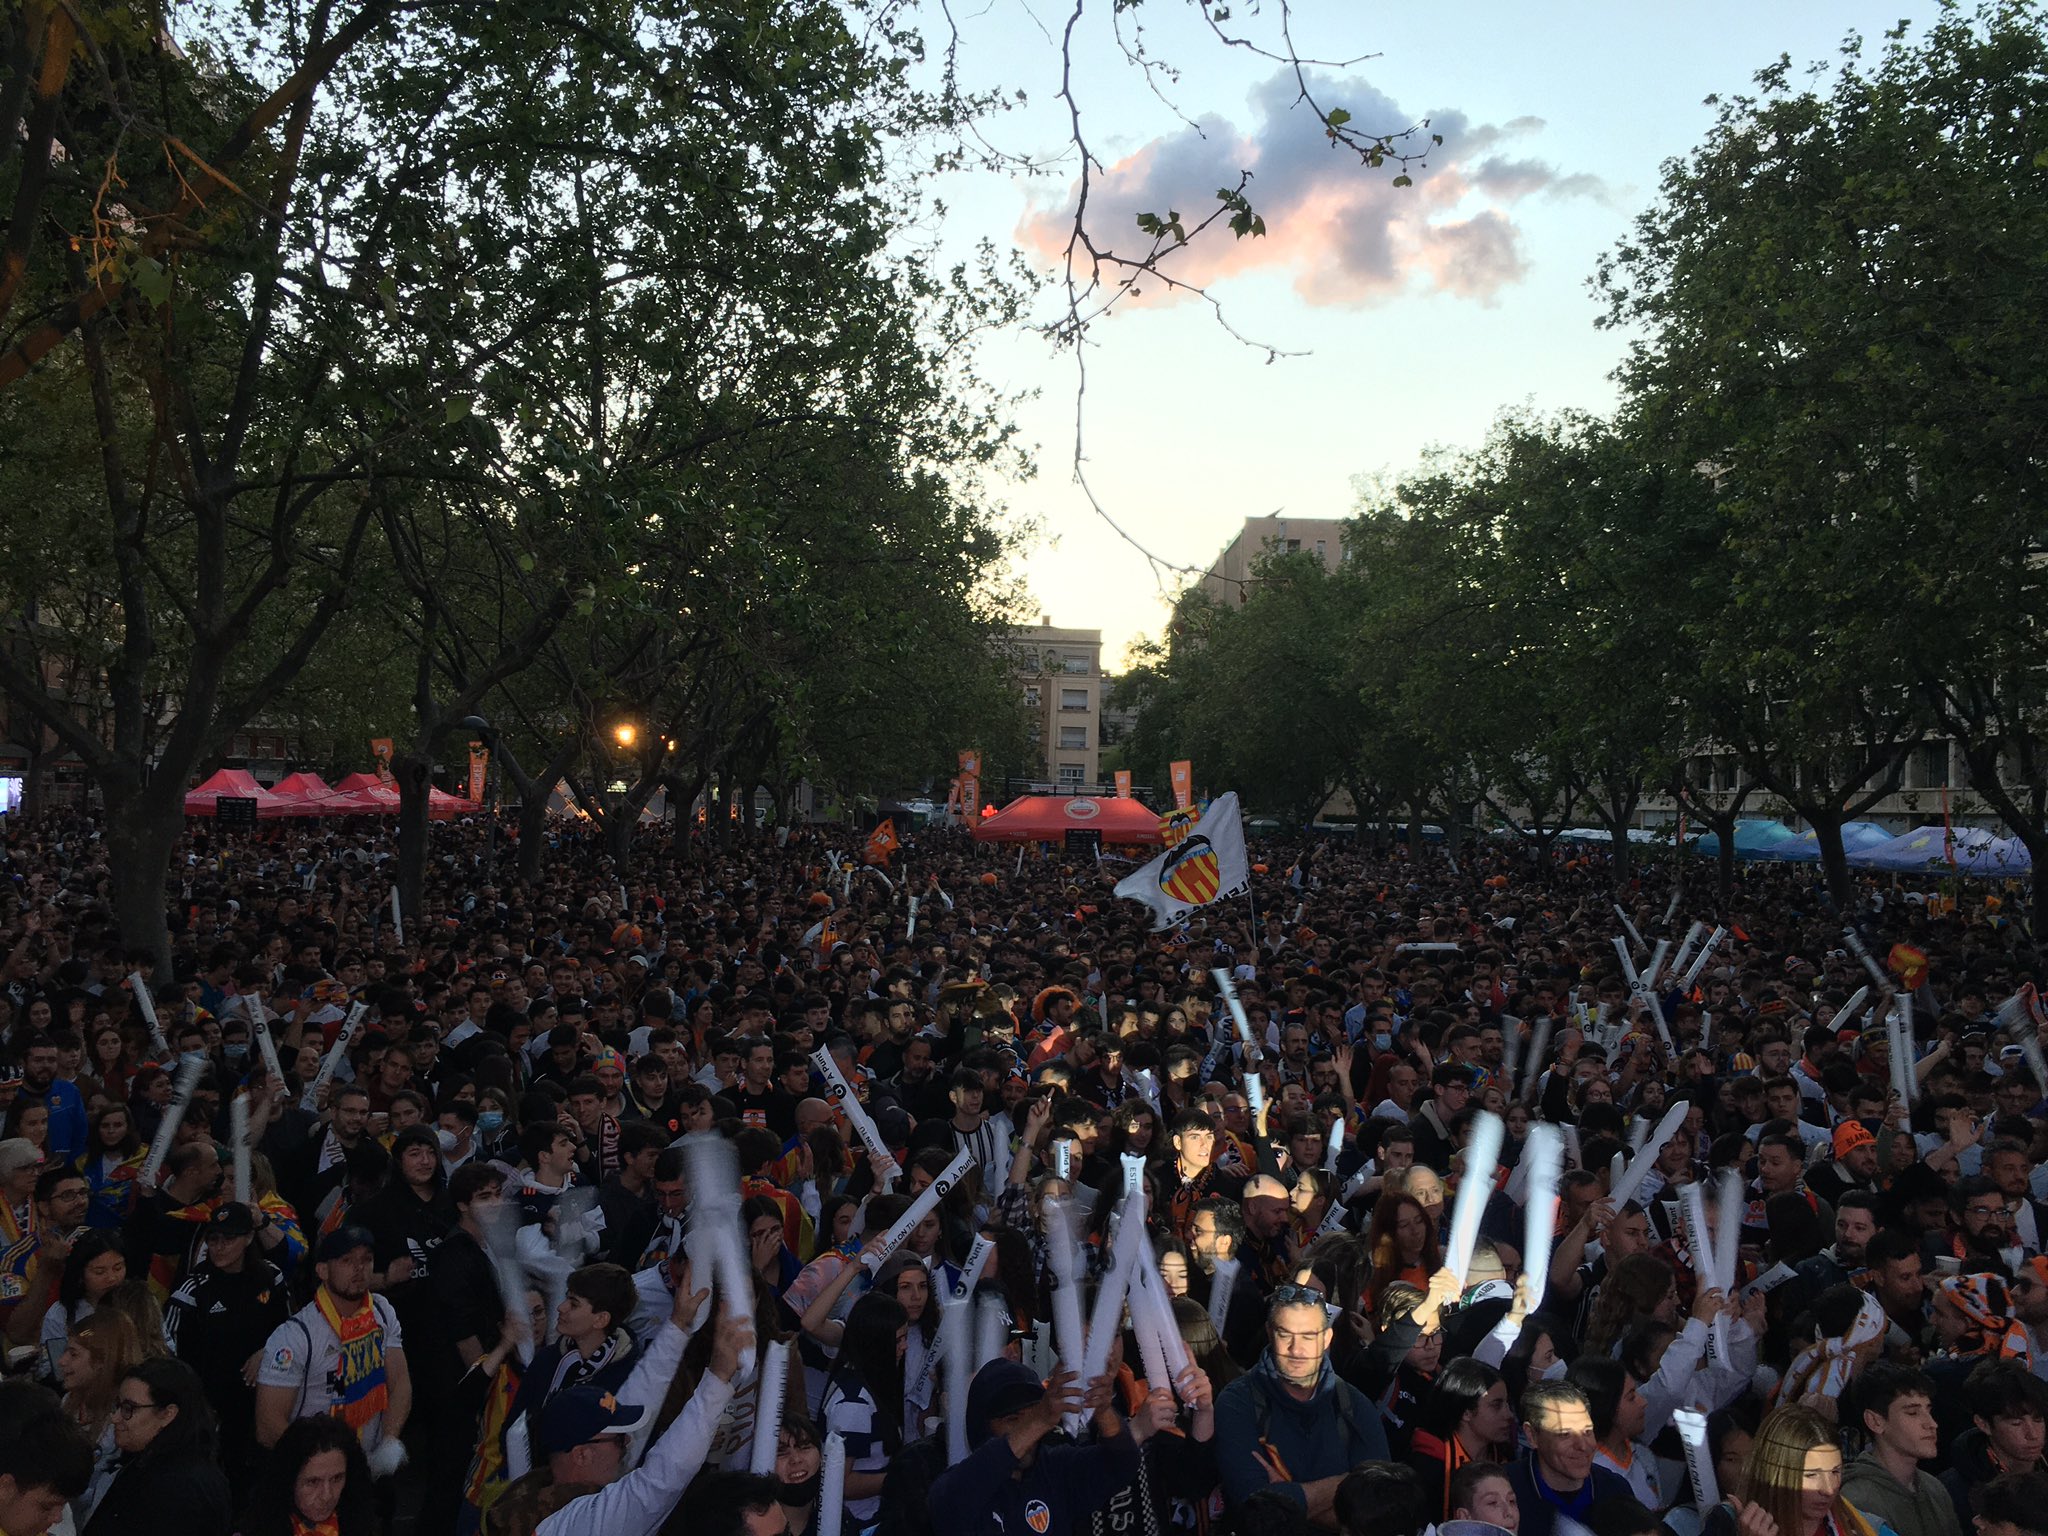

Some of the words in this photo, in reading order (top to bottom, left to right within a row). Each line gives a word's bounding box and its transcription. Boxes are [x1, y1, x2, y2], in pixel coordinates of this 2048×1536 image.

[957, 1154, 975, 1175] Punt
[1128, 1166, 1138, 1192] ESTE
[877, 1238, 899, 1262] ESTEM
[896, 1228, 908, 1241] ON
[905, 1218, 917, 1231] TU
[967, 1241, 985, 1267] Punt
